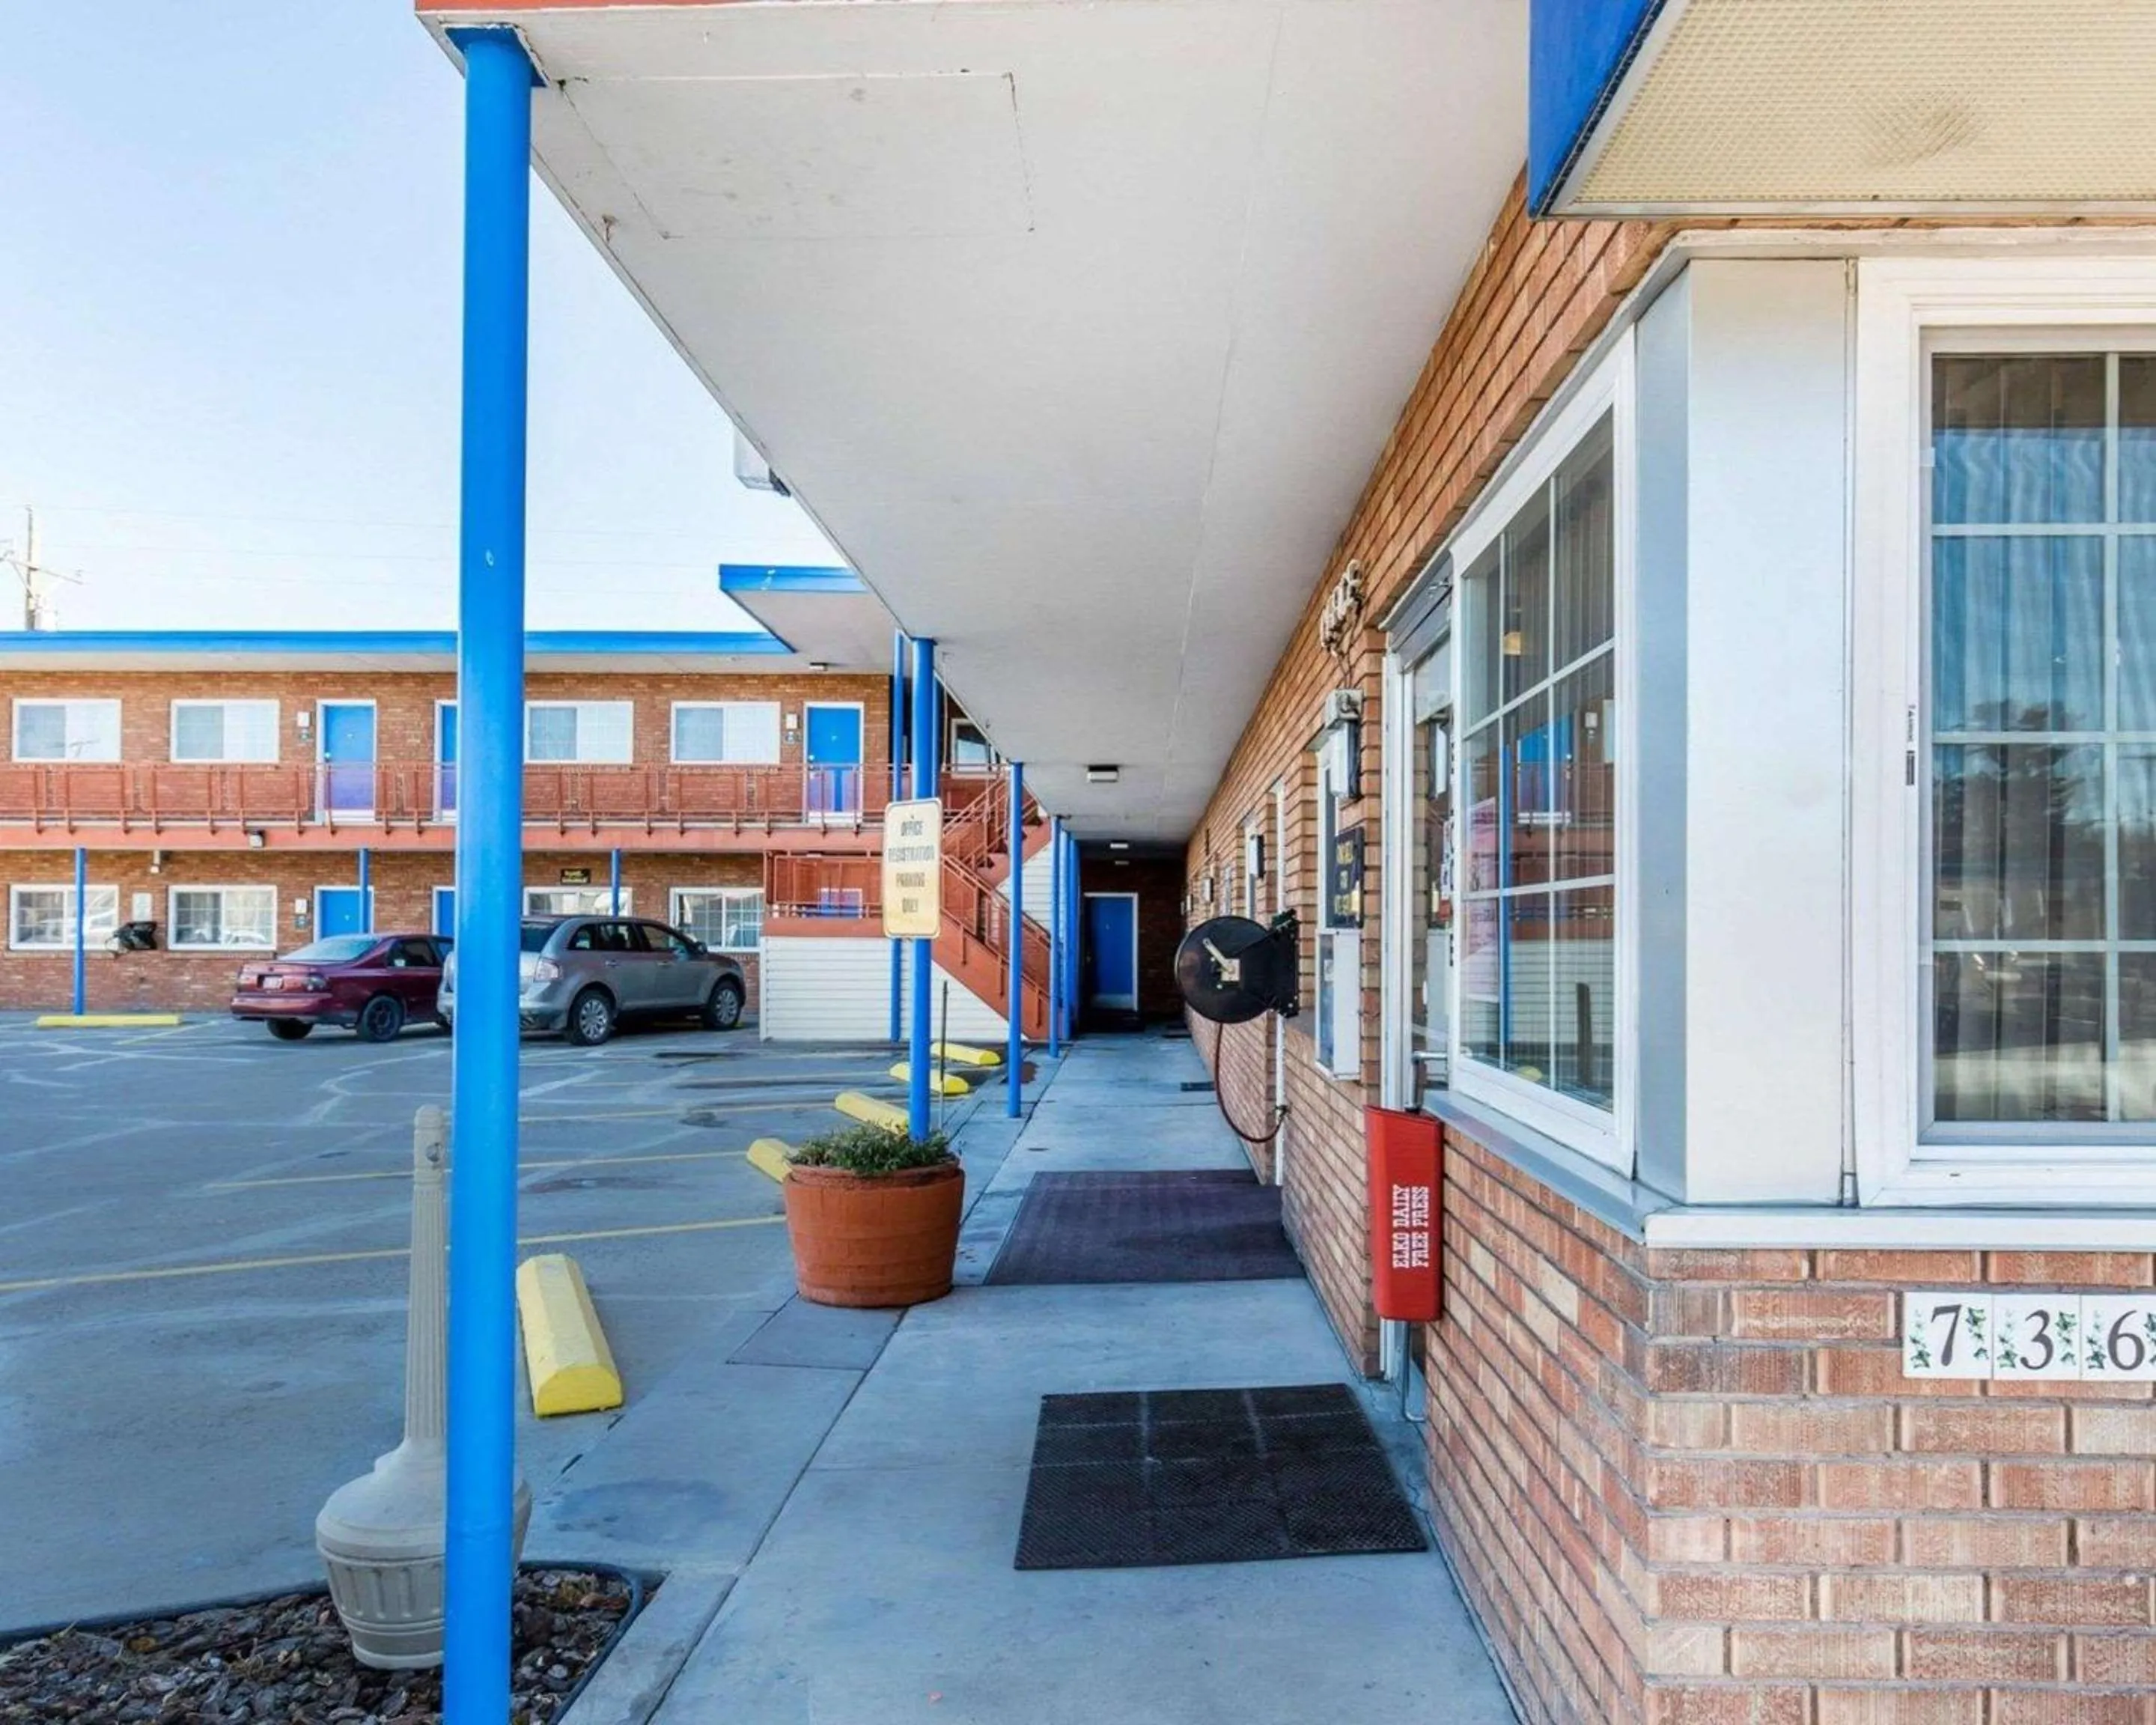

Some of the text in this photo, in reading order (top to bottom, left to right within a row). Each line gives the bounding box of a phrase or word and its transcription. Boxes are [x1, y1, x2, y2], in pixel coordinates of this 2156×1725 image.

[901, 820, 923, 836] OFFICE
[888, 845, 935, 862] REGISTRATION
[896, 871, 925, 888] PARKING
[1392, 1184, 1410, 1268] ELKO DAILY
[1411, 1186, 1429, 1268] FREE PRESS
[1930, 1303, 2146, 1371] 736
